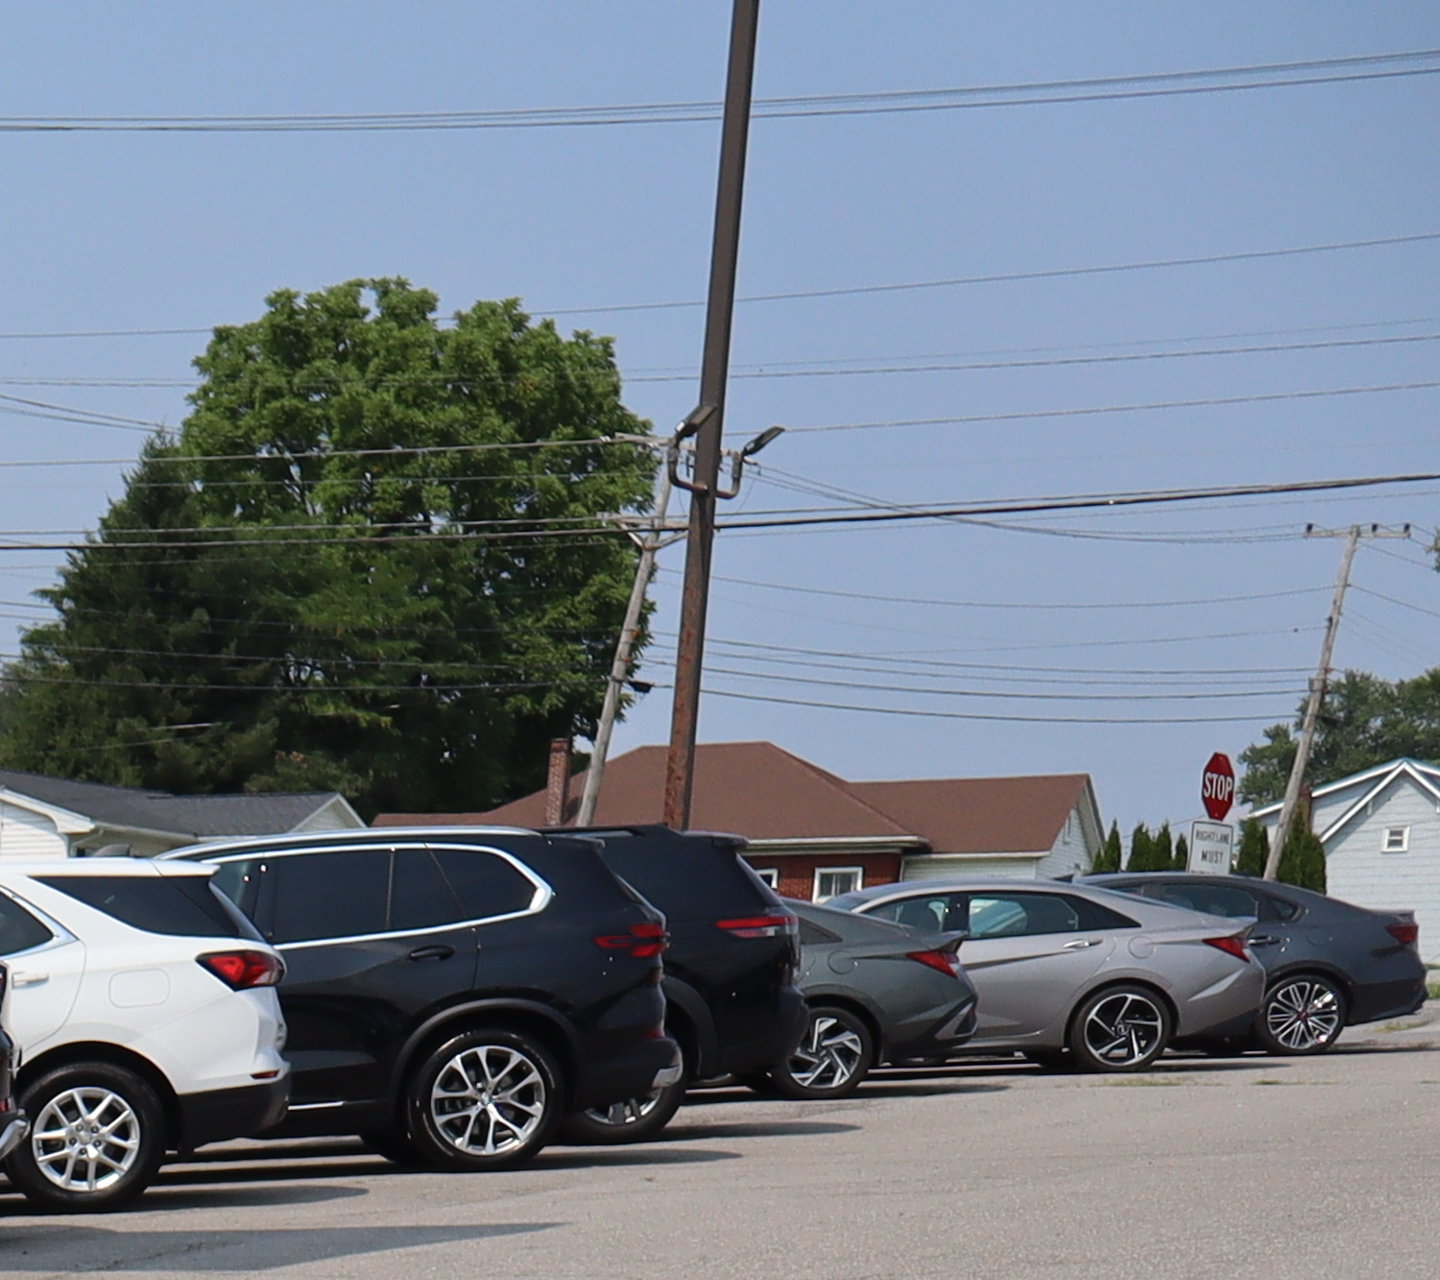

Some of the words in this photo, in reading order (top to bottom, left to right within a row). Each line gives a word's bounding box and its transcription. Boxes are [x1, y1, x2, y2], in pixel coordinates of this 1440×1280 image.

[1203, 772, 1233, 801] STOP
[1196, 830, 1215, 842] RIGHT
[1216, 833, 1230, 845] LANE
[1201, 850, 1223, 864] MUST
